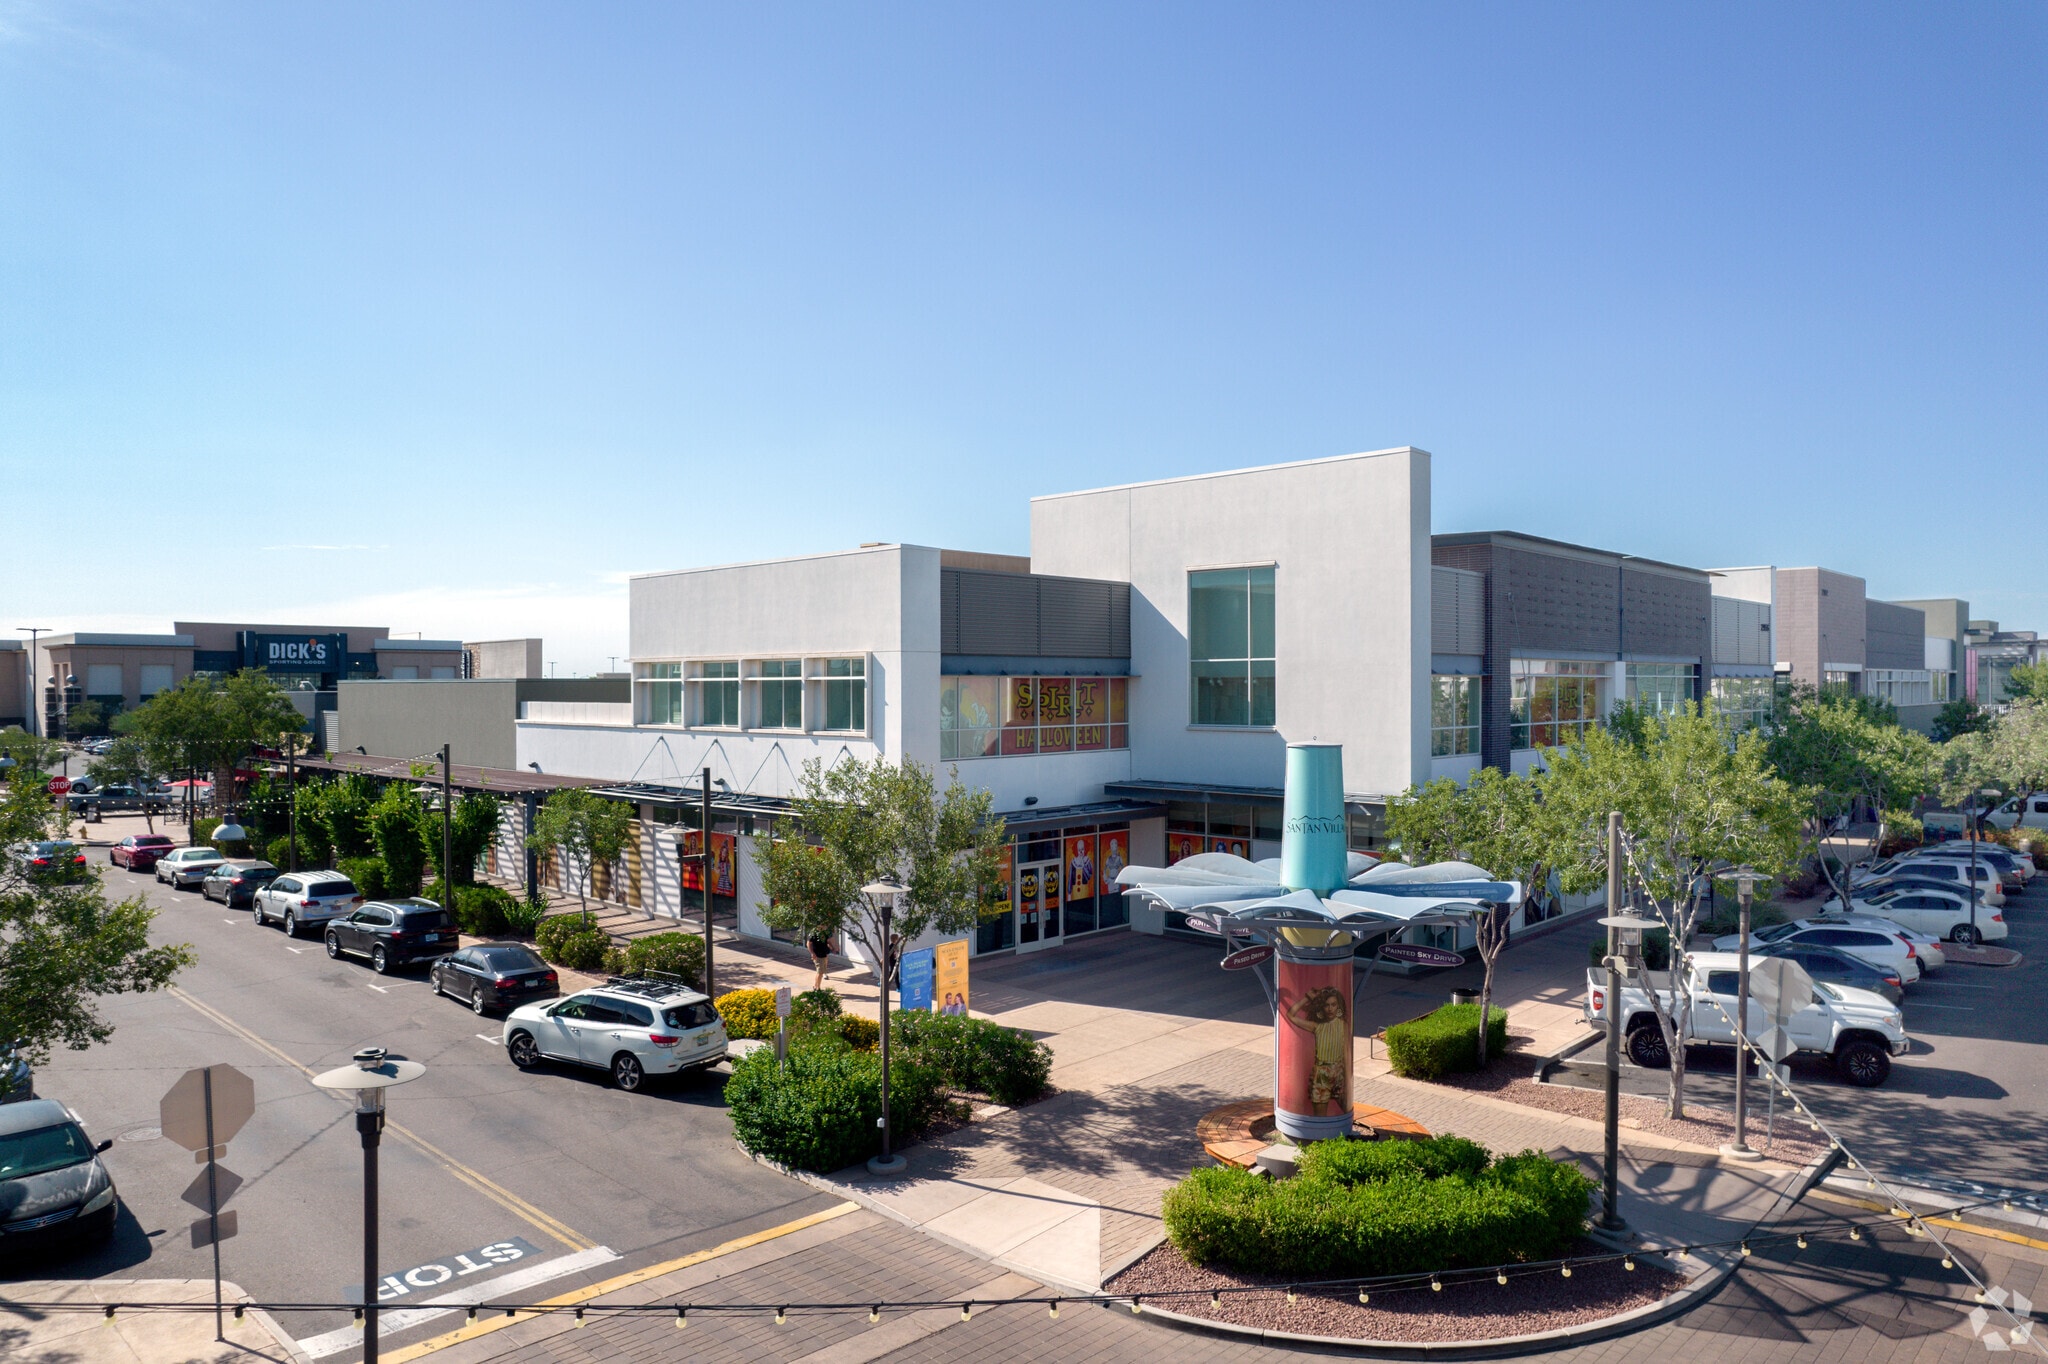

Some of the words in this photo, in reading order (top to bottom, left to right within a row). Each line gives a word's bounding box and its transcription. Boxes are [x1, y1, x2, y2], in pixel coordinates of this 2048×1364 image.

[269, 640, 326, 659] DICK'S
[50, 781, 70, 790] STOP
[1250, 951, 1266, 960] DRIVE
[1385, 946, 1416, 957] PAINTED
[1417, 951, 1432, 960] SKY
[1433, 953, 1457, 963] DRIVE
[377, 1242, 524, 1301] STOP
